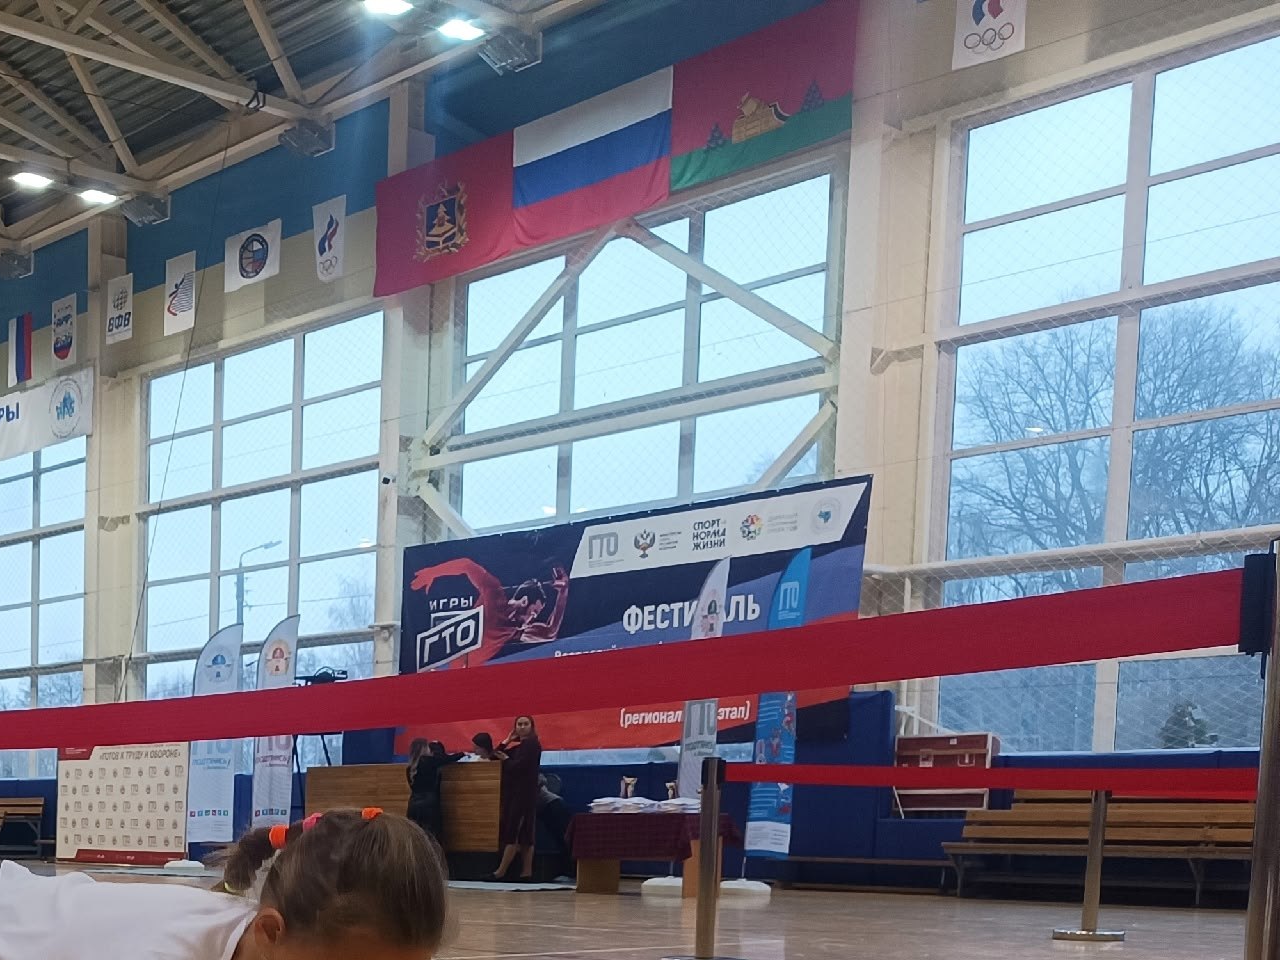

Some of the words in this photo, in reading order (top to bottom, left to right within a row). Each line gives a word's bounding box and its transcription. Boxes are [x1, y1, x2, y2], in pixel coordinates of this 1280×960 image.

[692, 528, 726, 541] НОРМА
[588, 532, 619, 560] ГТО
[692, 539, 726, 551] ЖИЗНИ
[429, 596, 473, 610] ИГРЫ
[623, 595, 760, 634] ФЕСТИЛЬ
[424, 619, 475, 663] ГТО
[717, 700, 751, 720] этап)
